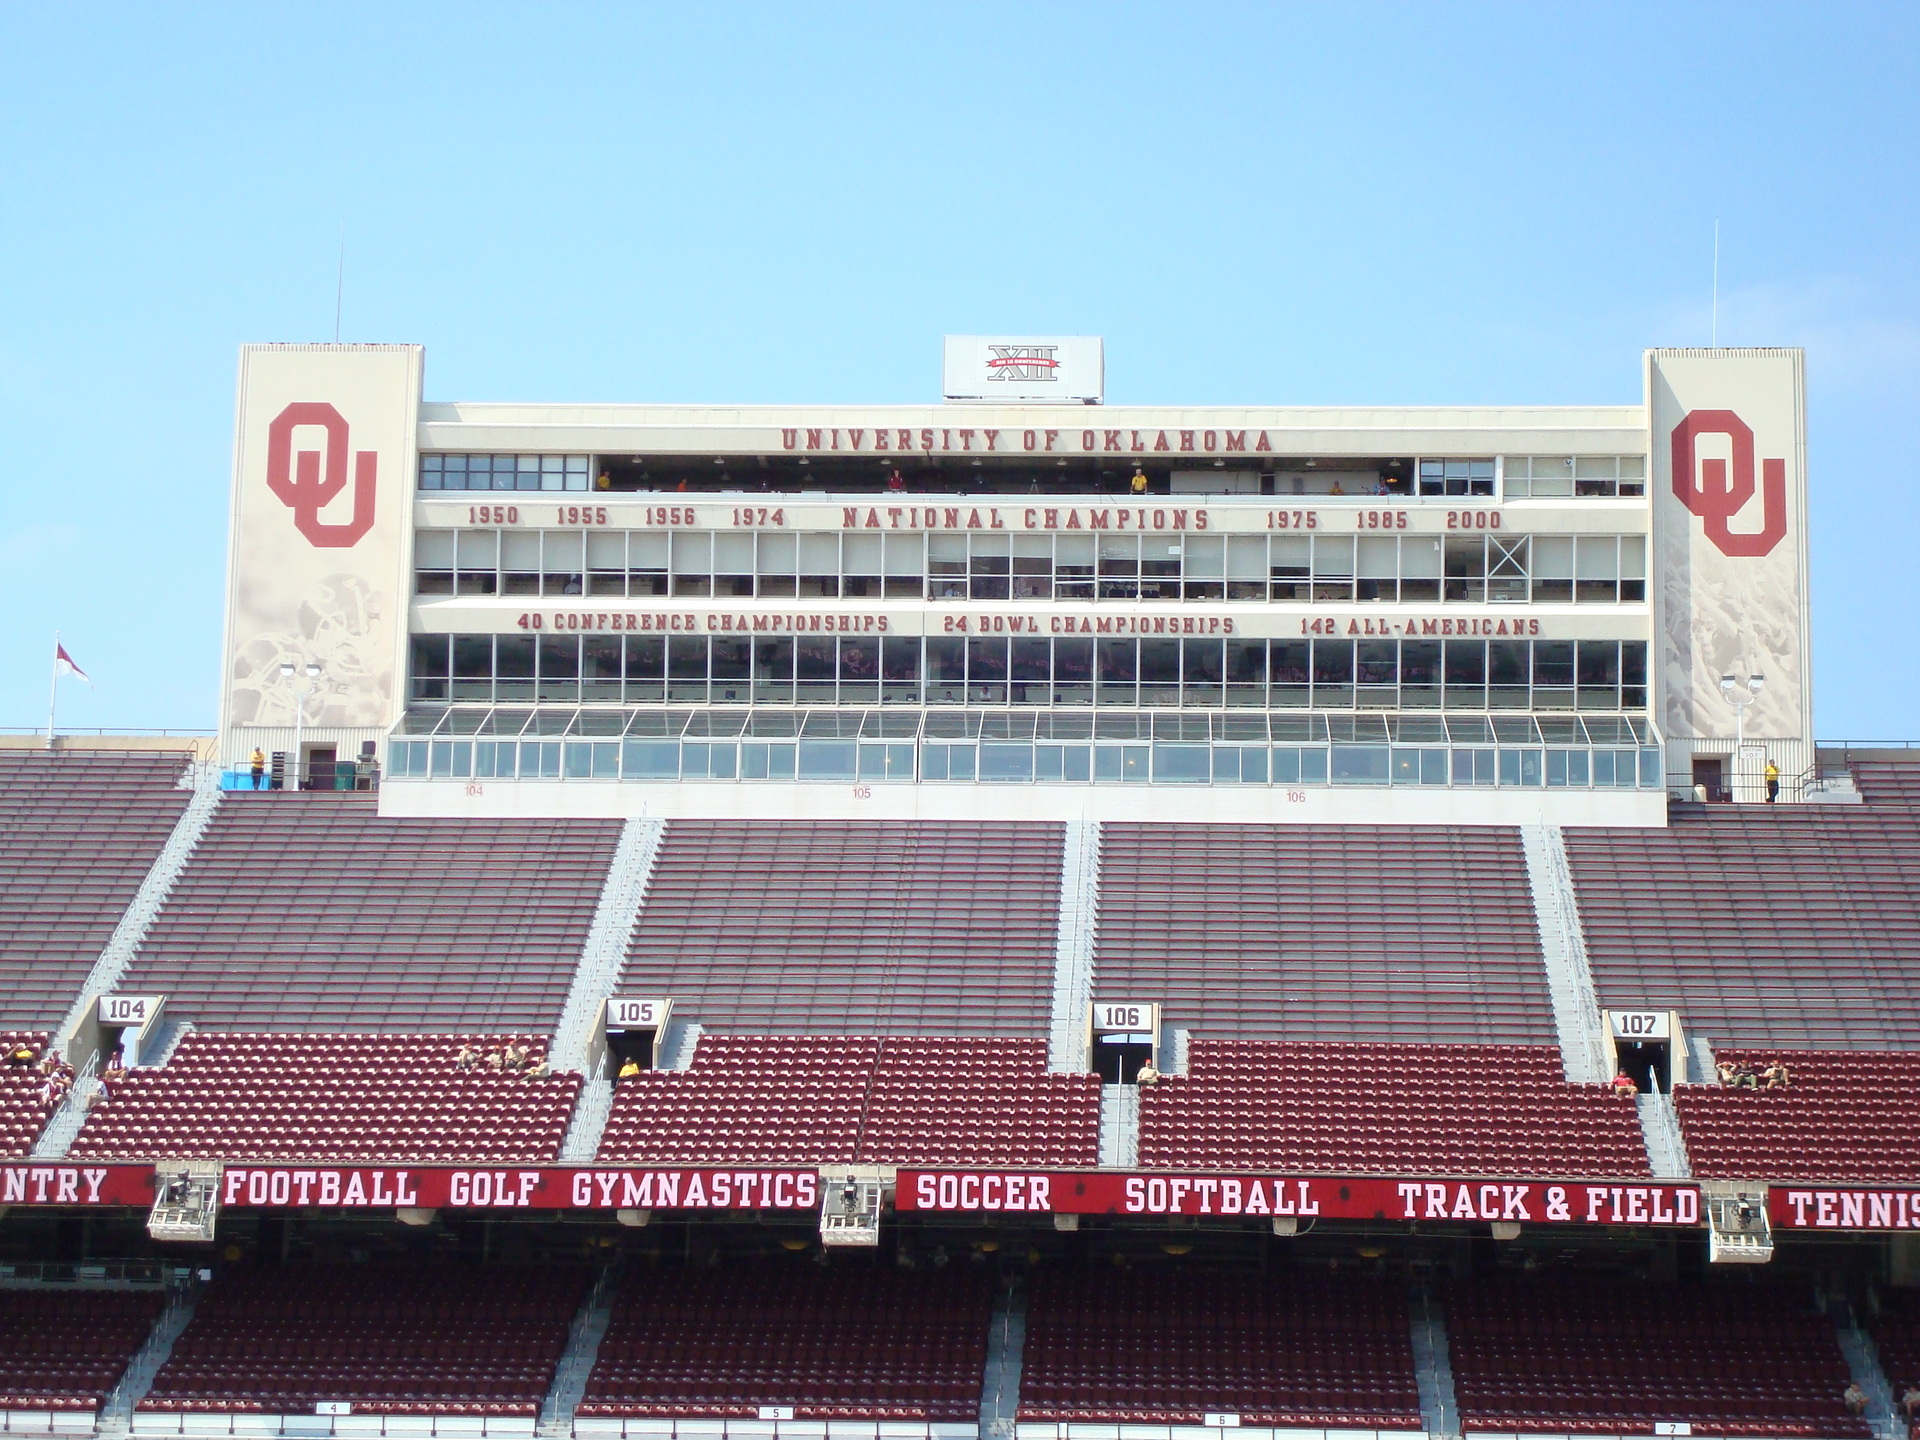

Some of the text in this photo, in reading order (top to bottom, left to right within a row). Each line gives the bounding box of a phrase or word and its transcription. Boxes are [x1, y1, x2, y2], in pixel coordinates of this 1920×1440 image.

[780, 428, 1272, 453] UNIVERSITY OF OKLAHOMA
[266, 402, 378, 548] OU
[1671, 409, 1787, 558] OU
[469, 506, 1501, 531] 1950 1955 1956 1974 NATIONAL CHAMPIONS 1975 1985 2000
[516, 613, 888, 632] 40 CONFERENCE CHAMPIONSHIPS
[943, 615, 1234, 634] 24 BOWL CHAMPIONSHIPS
[1300, 617, 1540, 636] 142 ALL-AMERICANS
[465, 785, 484, 796] 104
[852, 787, 871, 799] 105
[1286, 792, 1306, 802] 106
[110, 1000, 145, 1018] 104
[619, 1003, 653, 1021] 105
[1106, 1007, 1139, 1026] 106
[1621, 1015, 1656, 1034] 107
[0, 1167, 107, 1202] NTRY
[224, 1170, 417, 1206] FOOTBALL
[450, 1171, 540, 1206] GOLF
[572, 1172, 816, 1207] GYMNASTICS
[917, 1174, 1051, 1210] SOCCER
[1125, 1178, 1320, 1215] SOFTBALL
[1398, 1183, 1698, 1224] TRACK & FIELD
[330, 1403, 337, 1413] 4
[773, 1408, 780, 1418] 5
[1219, 1415, 1226, 1425] 6
